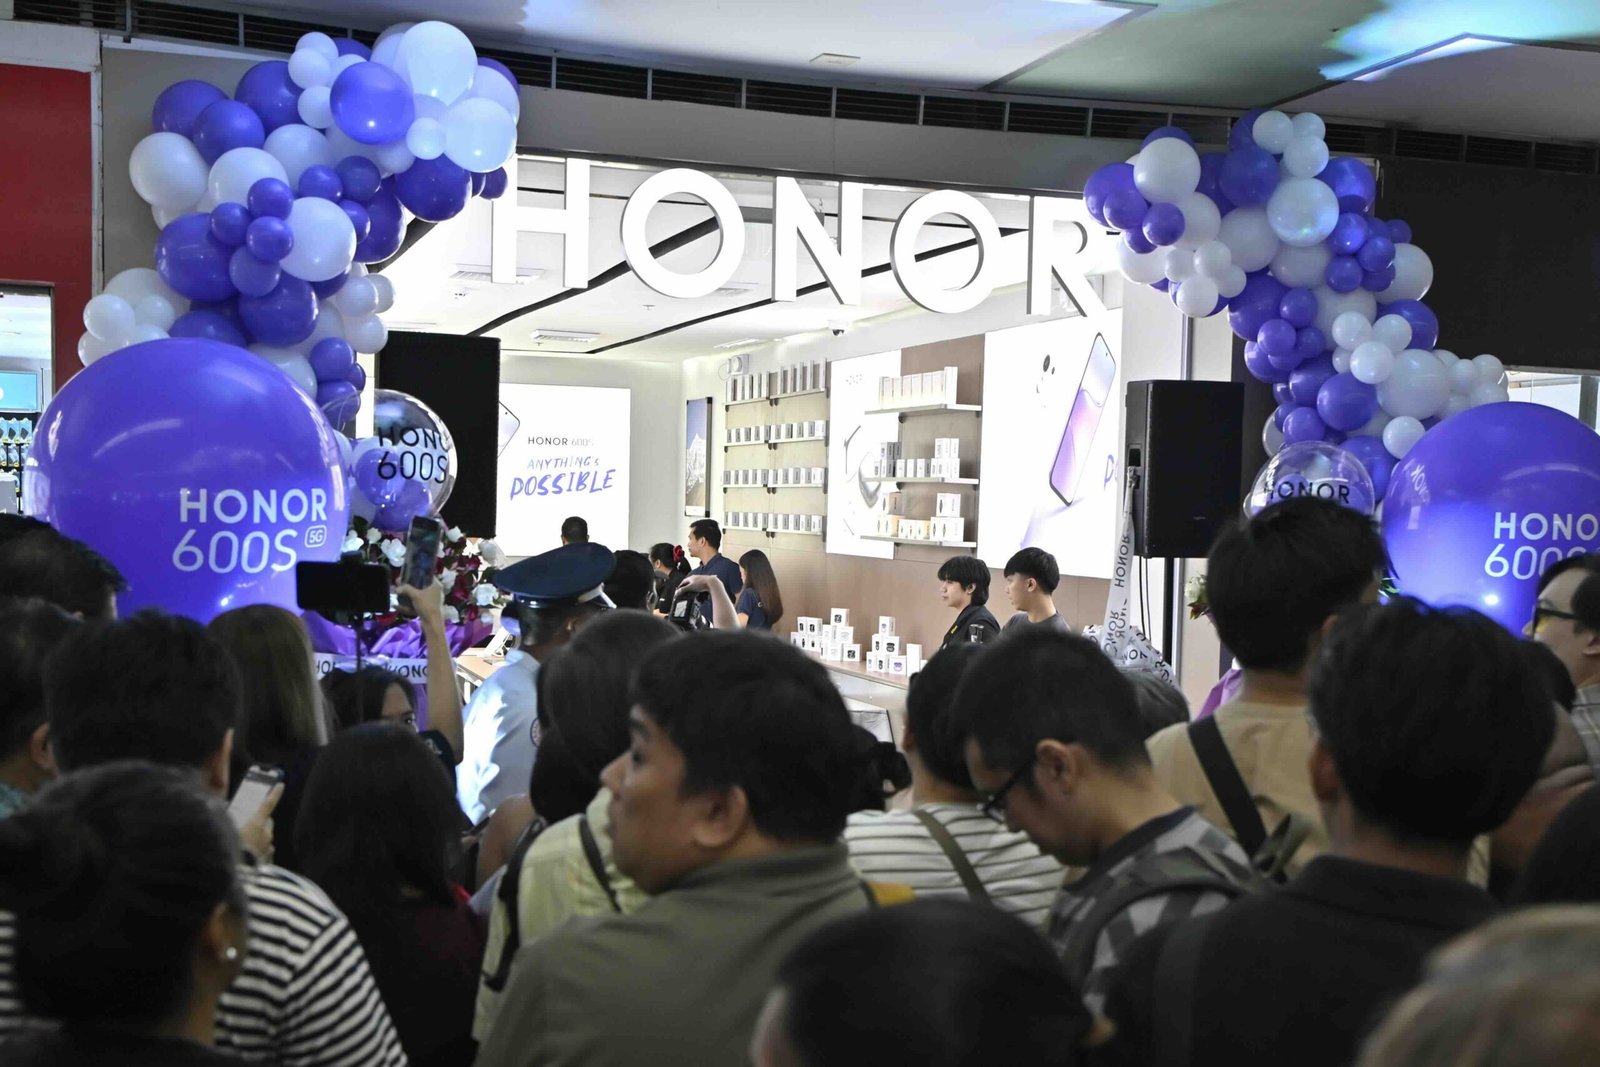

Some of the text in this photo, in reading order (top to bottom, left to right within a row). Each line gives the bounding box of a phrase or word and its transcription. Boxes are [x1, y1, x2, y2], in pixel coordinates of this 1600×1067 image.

[491, 155, 1108, 318] HONOR
[528, 437, 568, 446] HONOR
[377, 451, 447, 484] 600S
[510, 469, 616, 501] POSSIBLE
[180, 488, 327, 524] HONOR
[172, 529, 325, 573] 600S 5G
